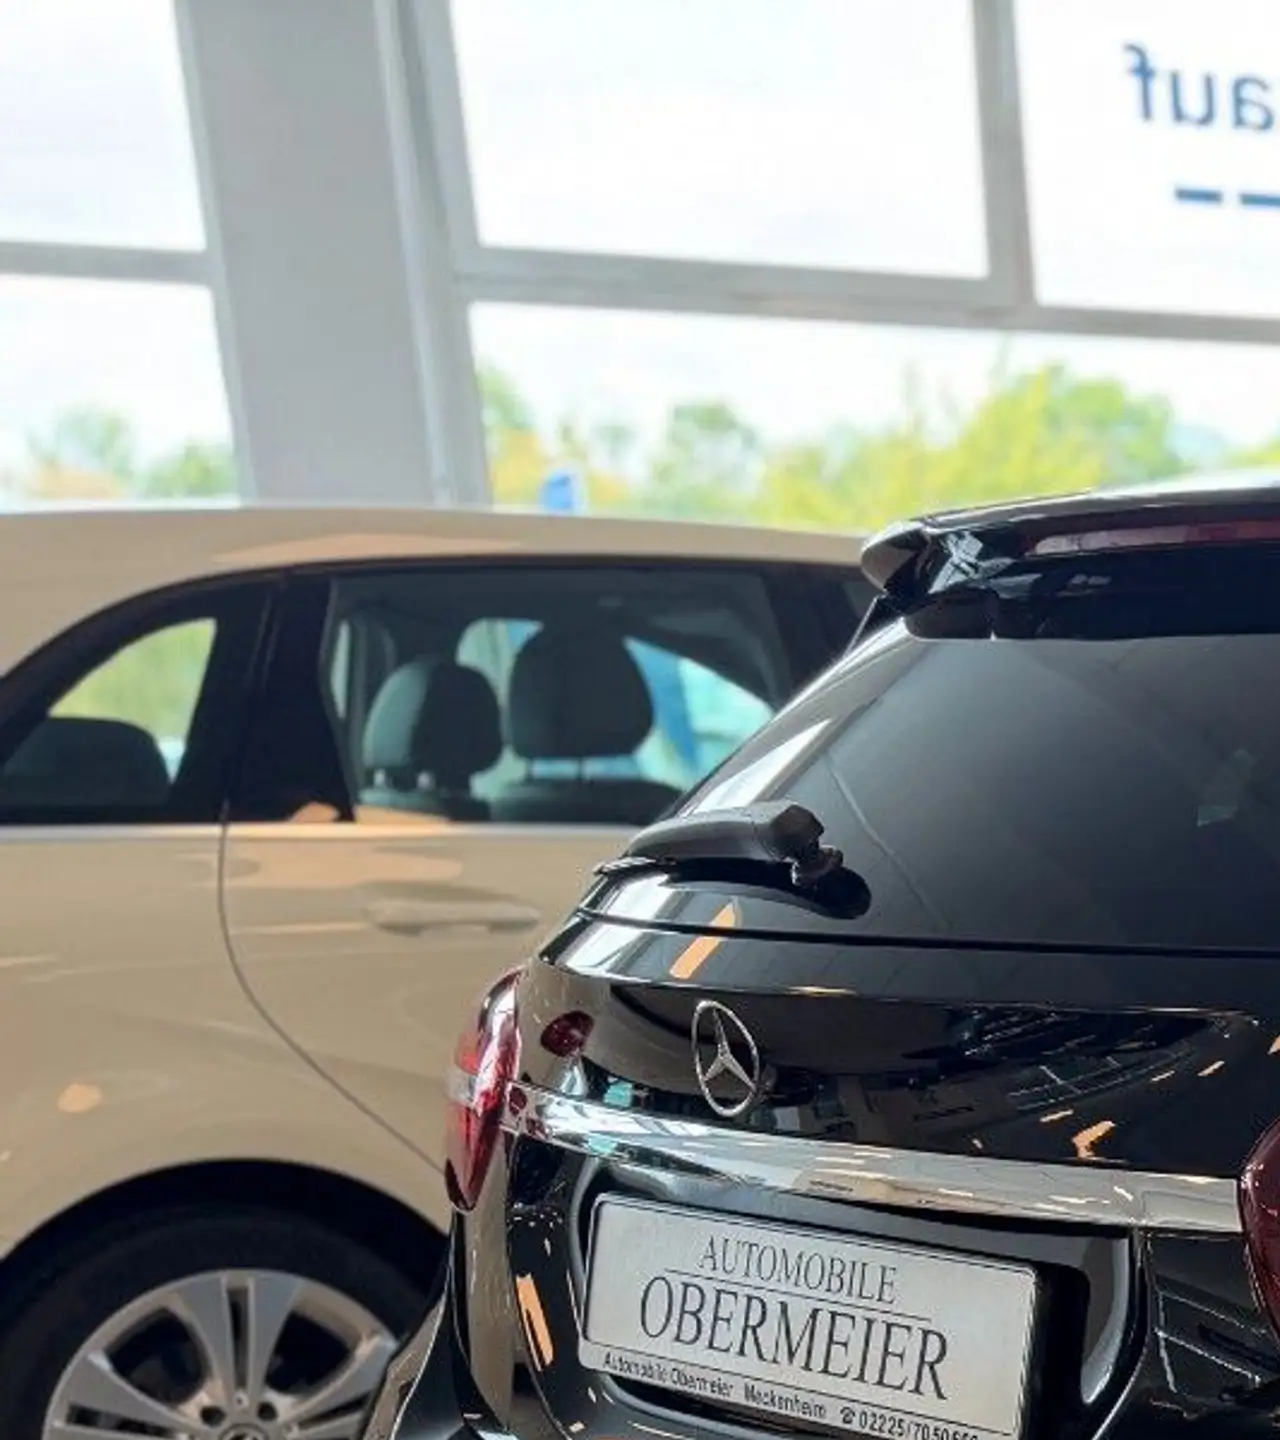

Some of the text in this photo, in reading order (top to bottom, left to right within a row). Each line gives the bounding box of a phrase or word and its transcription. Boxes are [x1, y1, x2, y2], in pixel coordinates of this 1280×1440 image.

[699, 1236, 898, 1304] AUTOMOBILE
[640, 1276, 949, 1400] OBERMEIER
[744, 1382, 827, 1419] Meckenheim
